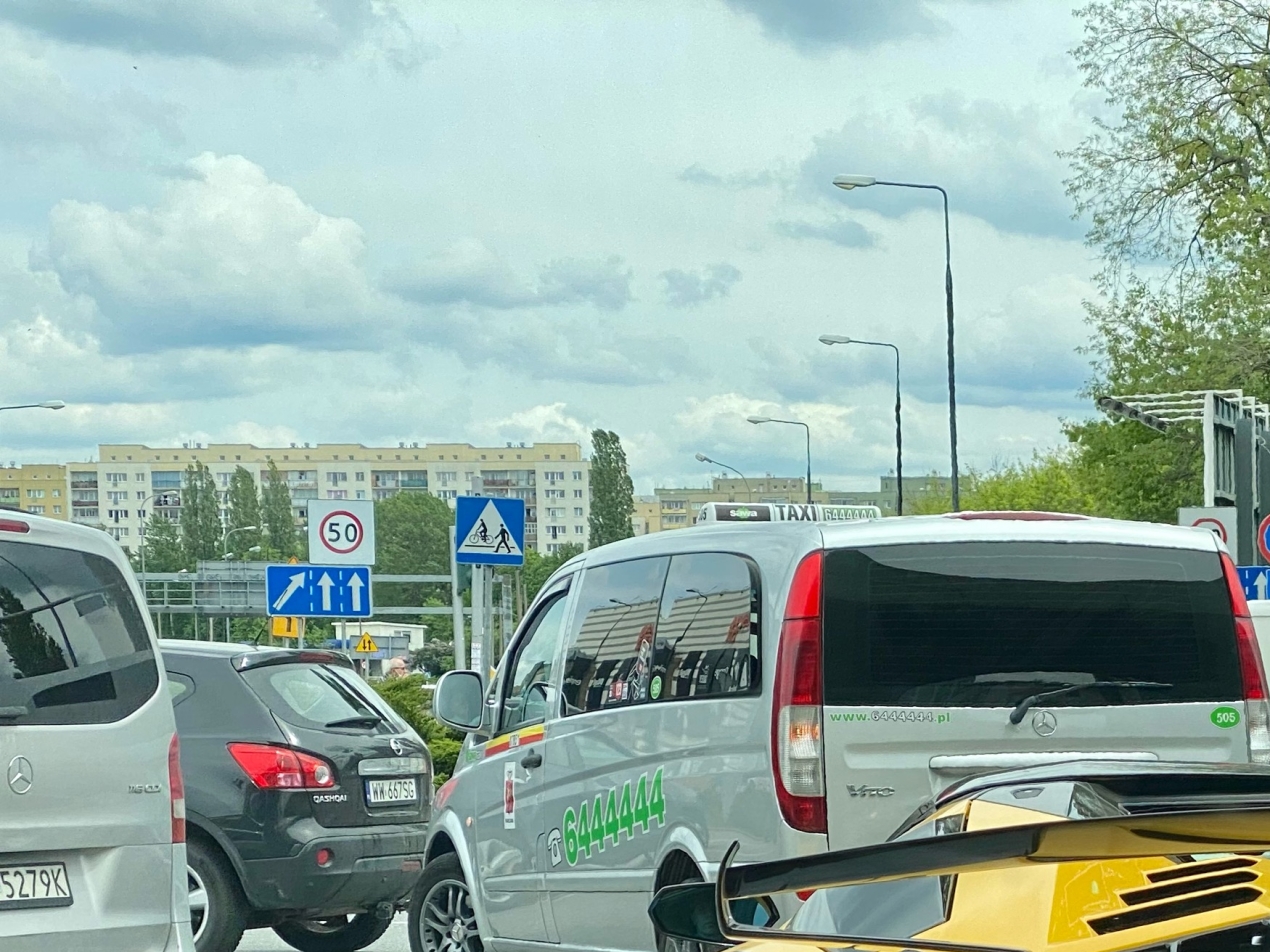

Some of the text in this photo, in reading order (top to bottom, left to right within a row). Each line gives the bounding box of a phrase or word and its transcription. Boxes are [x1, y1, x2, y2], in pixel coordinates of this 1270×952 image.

[774, 504, 818, 522] TAXI
[328, 522, 358, 543] 50
[830, 710, 950, 724] www.6444444.pl
[1216, 712, 1236, 724] 505
[313, 794, 348, 804] QASHQAI
[388, 781, 415, 800] 667SG
[562, 765, 667, 867] 6444444
